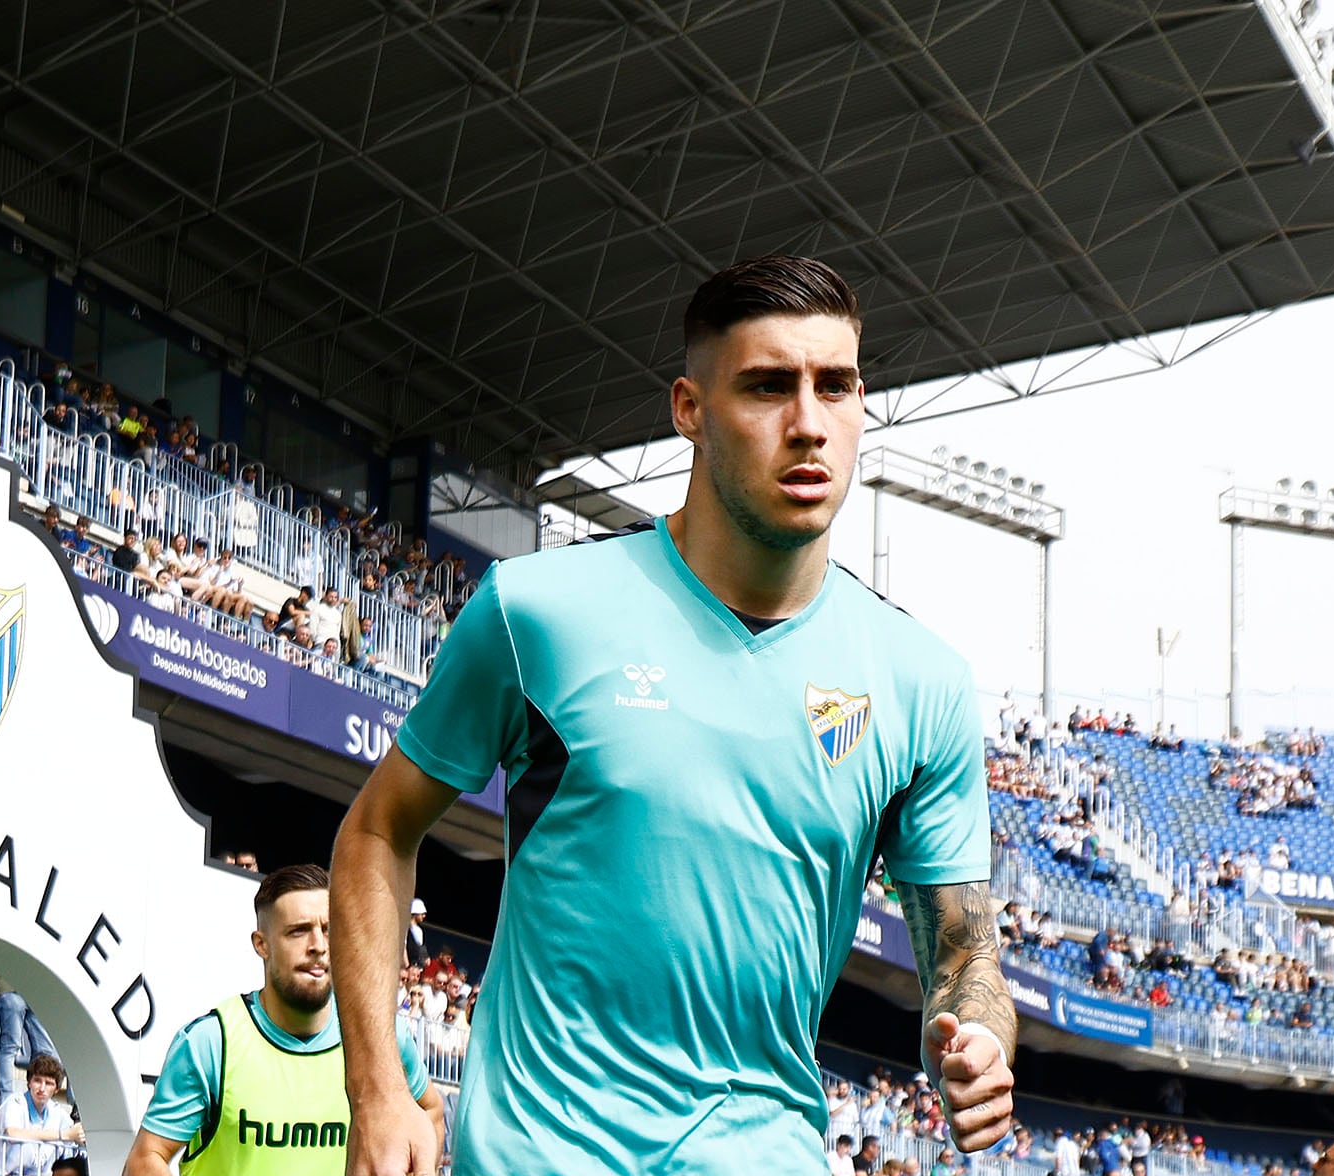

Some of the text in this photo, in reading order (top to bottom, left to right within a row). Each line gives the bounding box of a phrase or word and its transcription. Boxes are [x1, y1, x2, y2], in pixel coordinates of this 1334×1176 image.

[76, 296, 89, 314] 16
[130, 613, 267, 688] Abalón Abogados
[153, 652, 248, 700] Despacho Multidisciplinar
[615, 693, 669, 711] hummel
